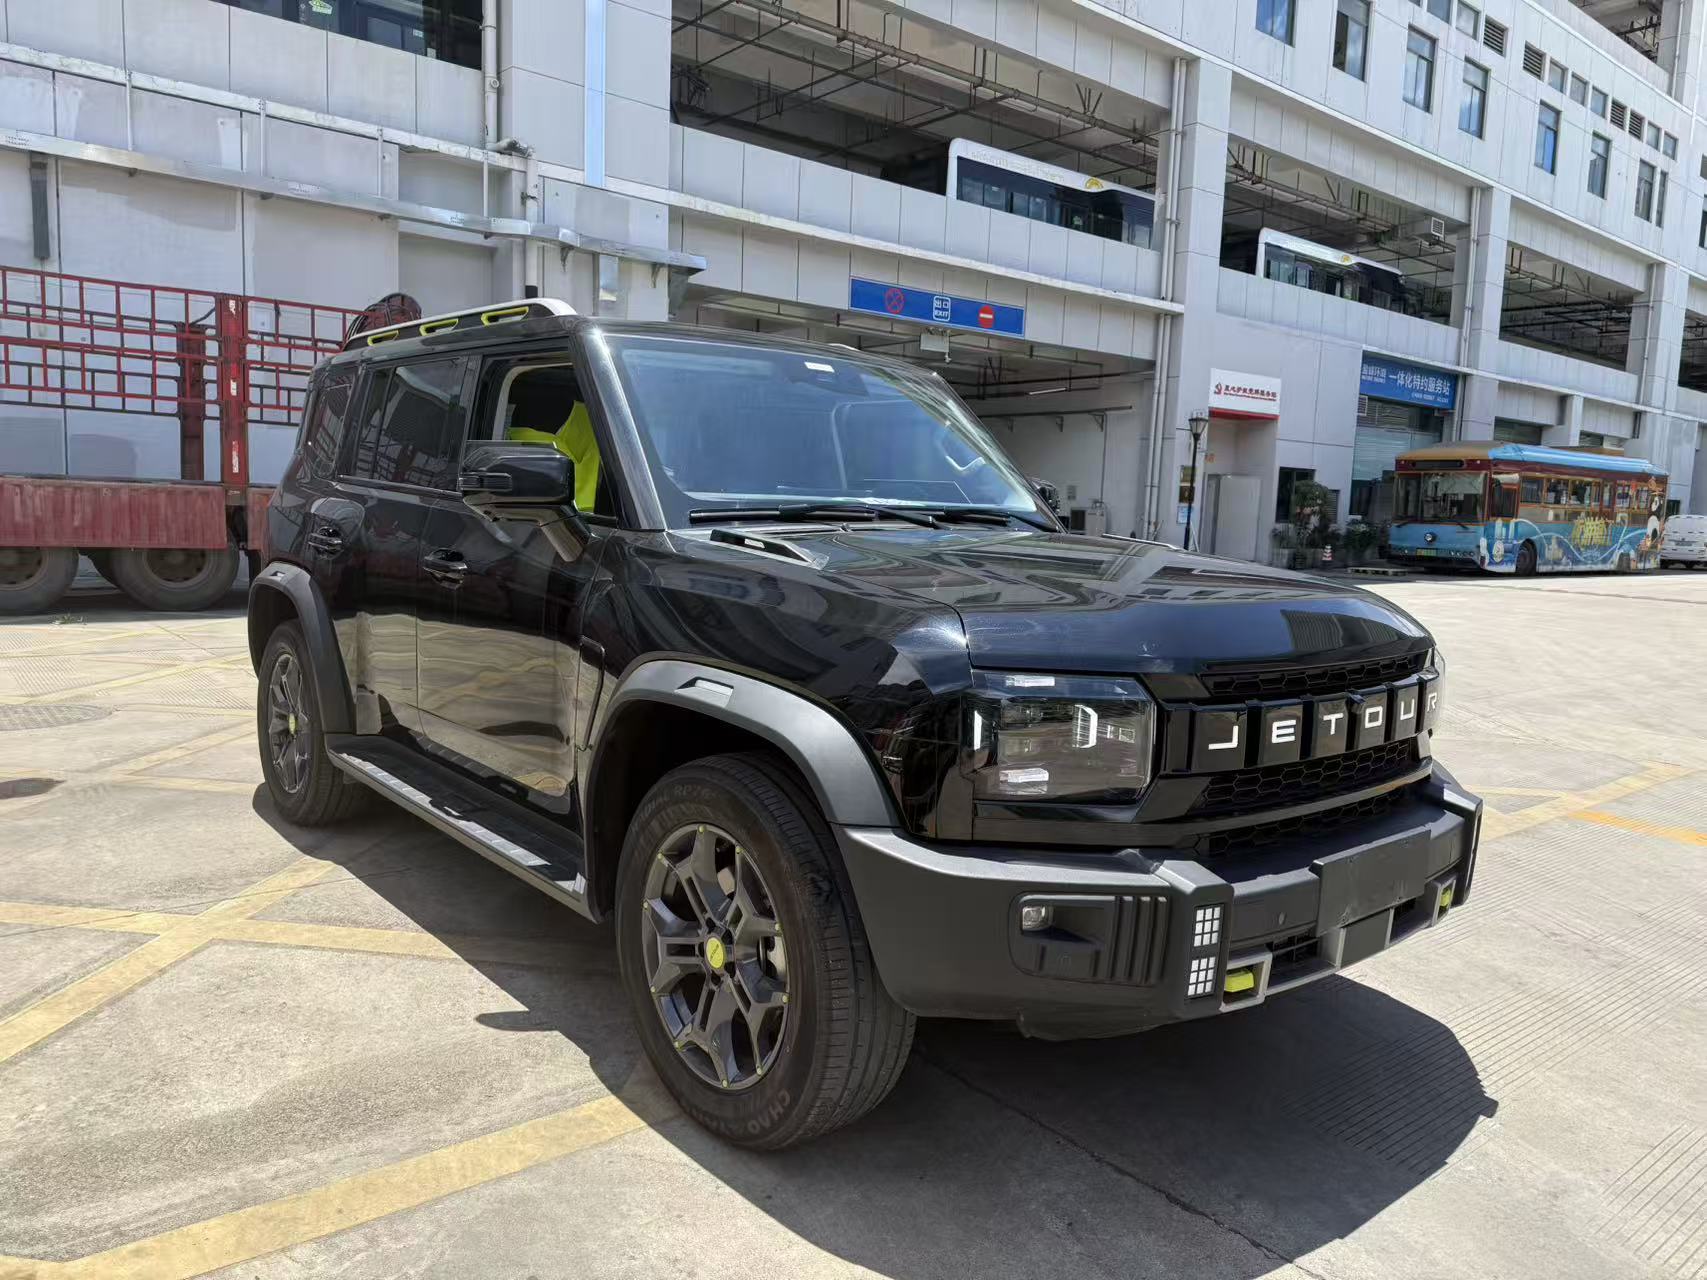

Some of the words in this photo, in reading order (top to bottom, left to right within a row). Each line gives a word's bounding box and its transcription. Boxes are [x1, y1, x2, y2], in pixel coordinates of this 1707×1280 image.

[935, 299, 949, 308] 出口
[1389, 370, 1451, 396] 一体化特约服务站
[1208, 692, 1437, 750] JETOUR
